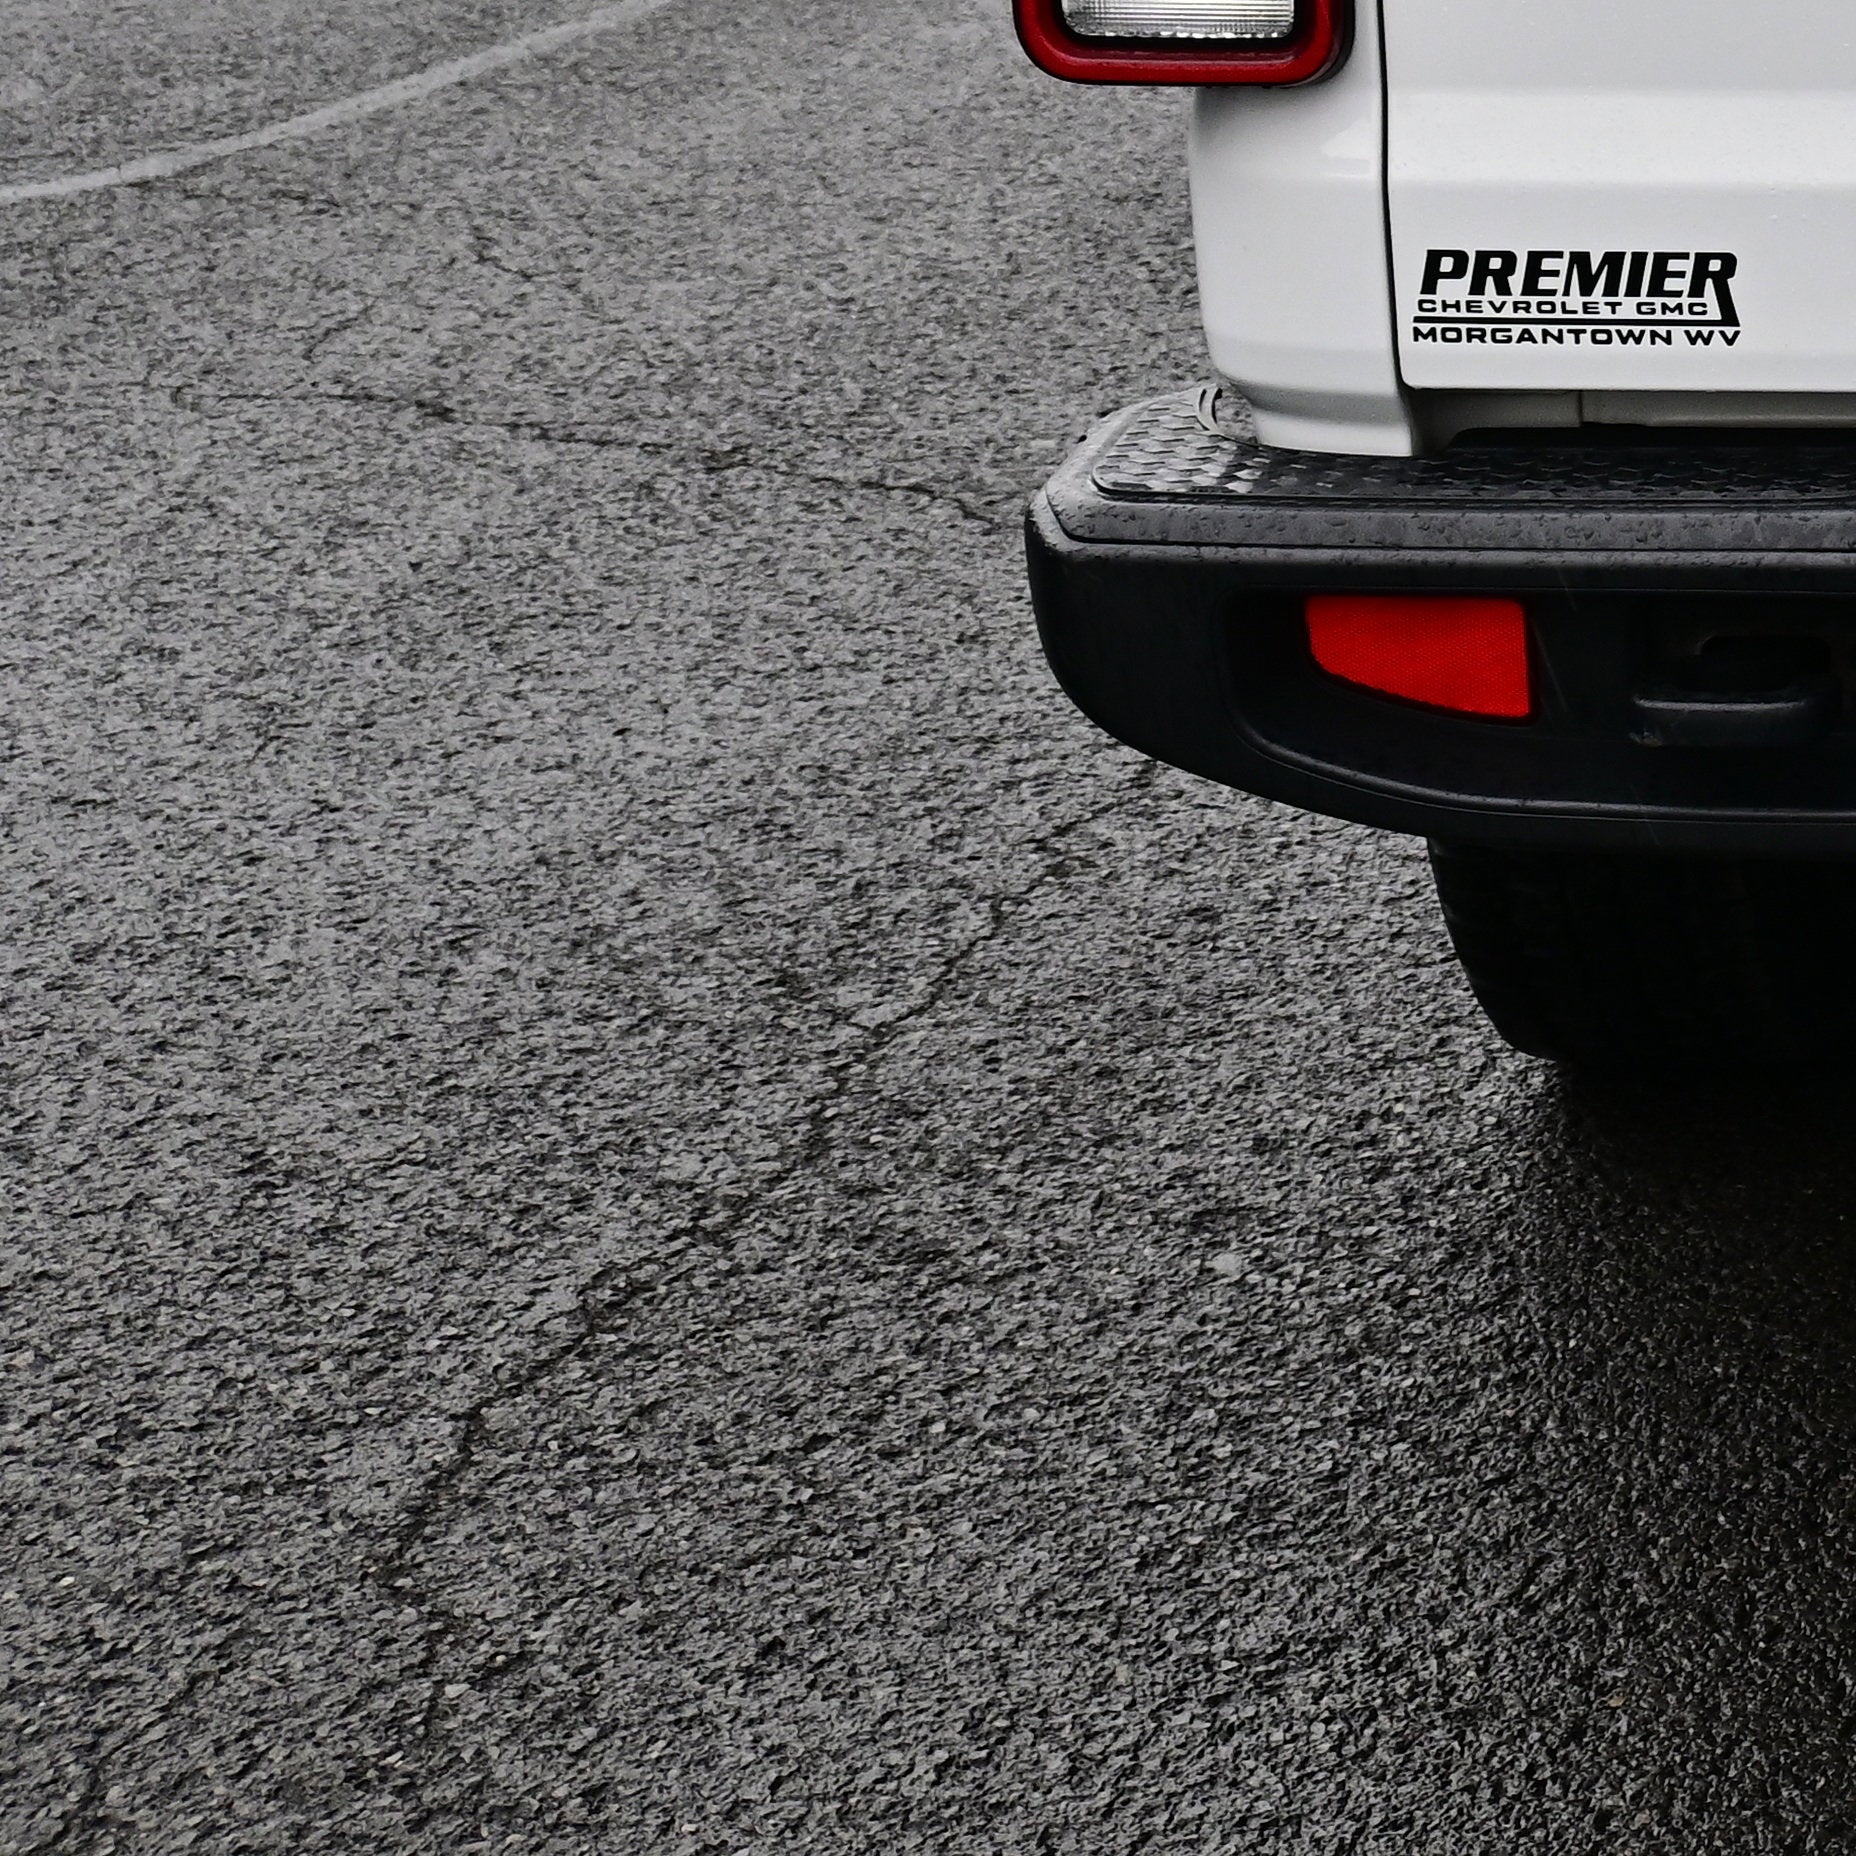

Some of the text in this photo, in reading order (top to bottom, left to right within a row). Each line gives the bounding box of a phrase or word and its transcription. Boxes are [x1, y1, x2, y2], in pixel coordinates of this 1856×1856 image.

[1420, 249, 1740, 327] PREMIER
[1417, 298, 1708, 317] CHEVROLET GMC
[1412, 326, 1741, 347] MORGANTOWN WV
